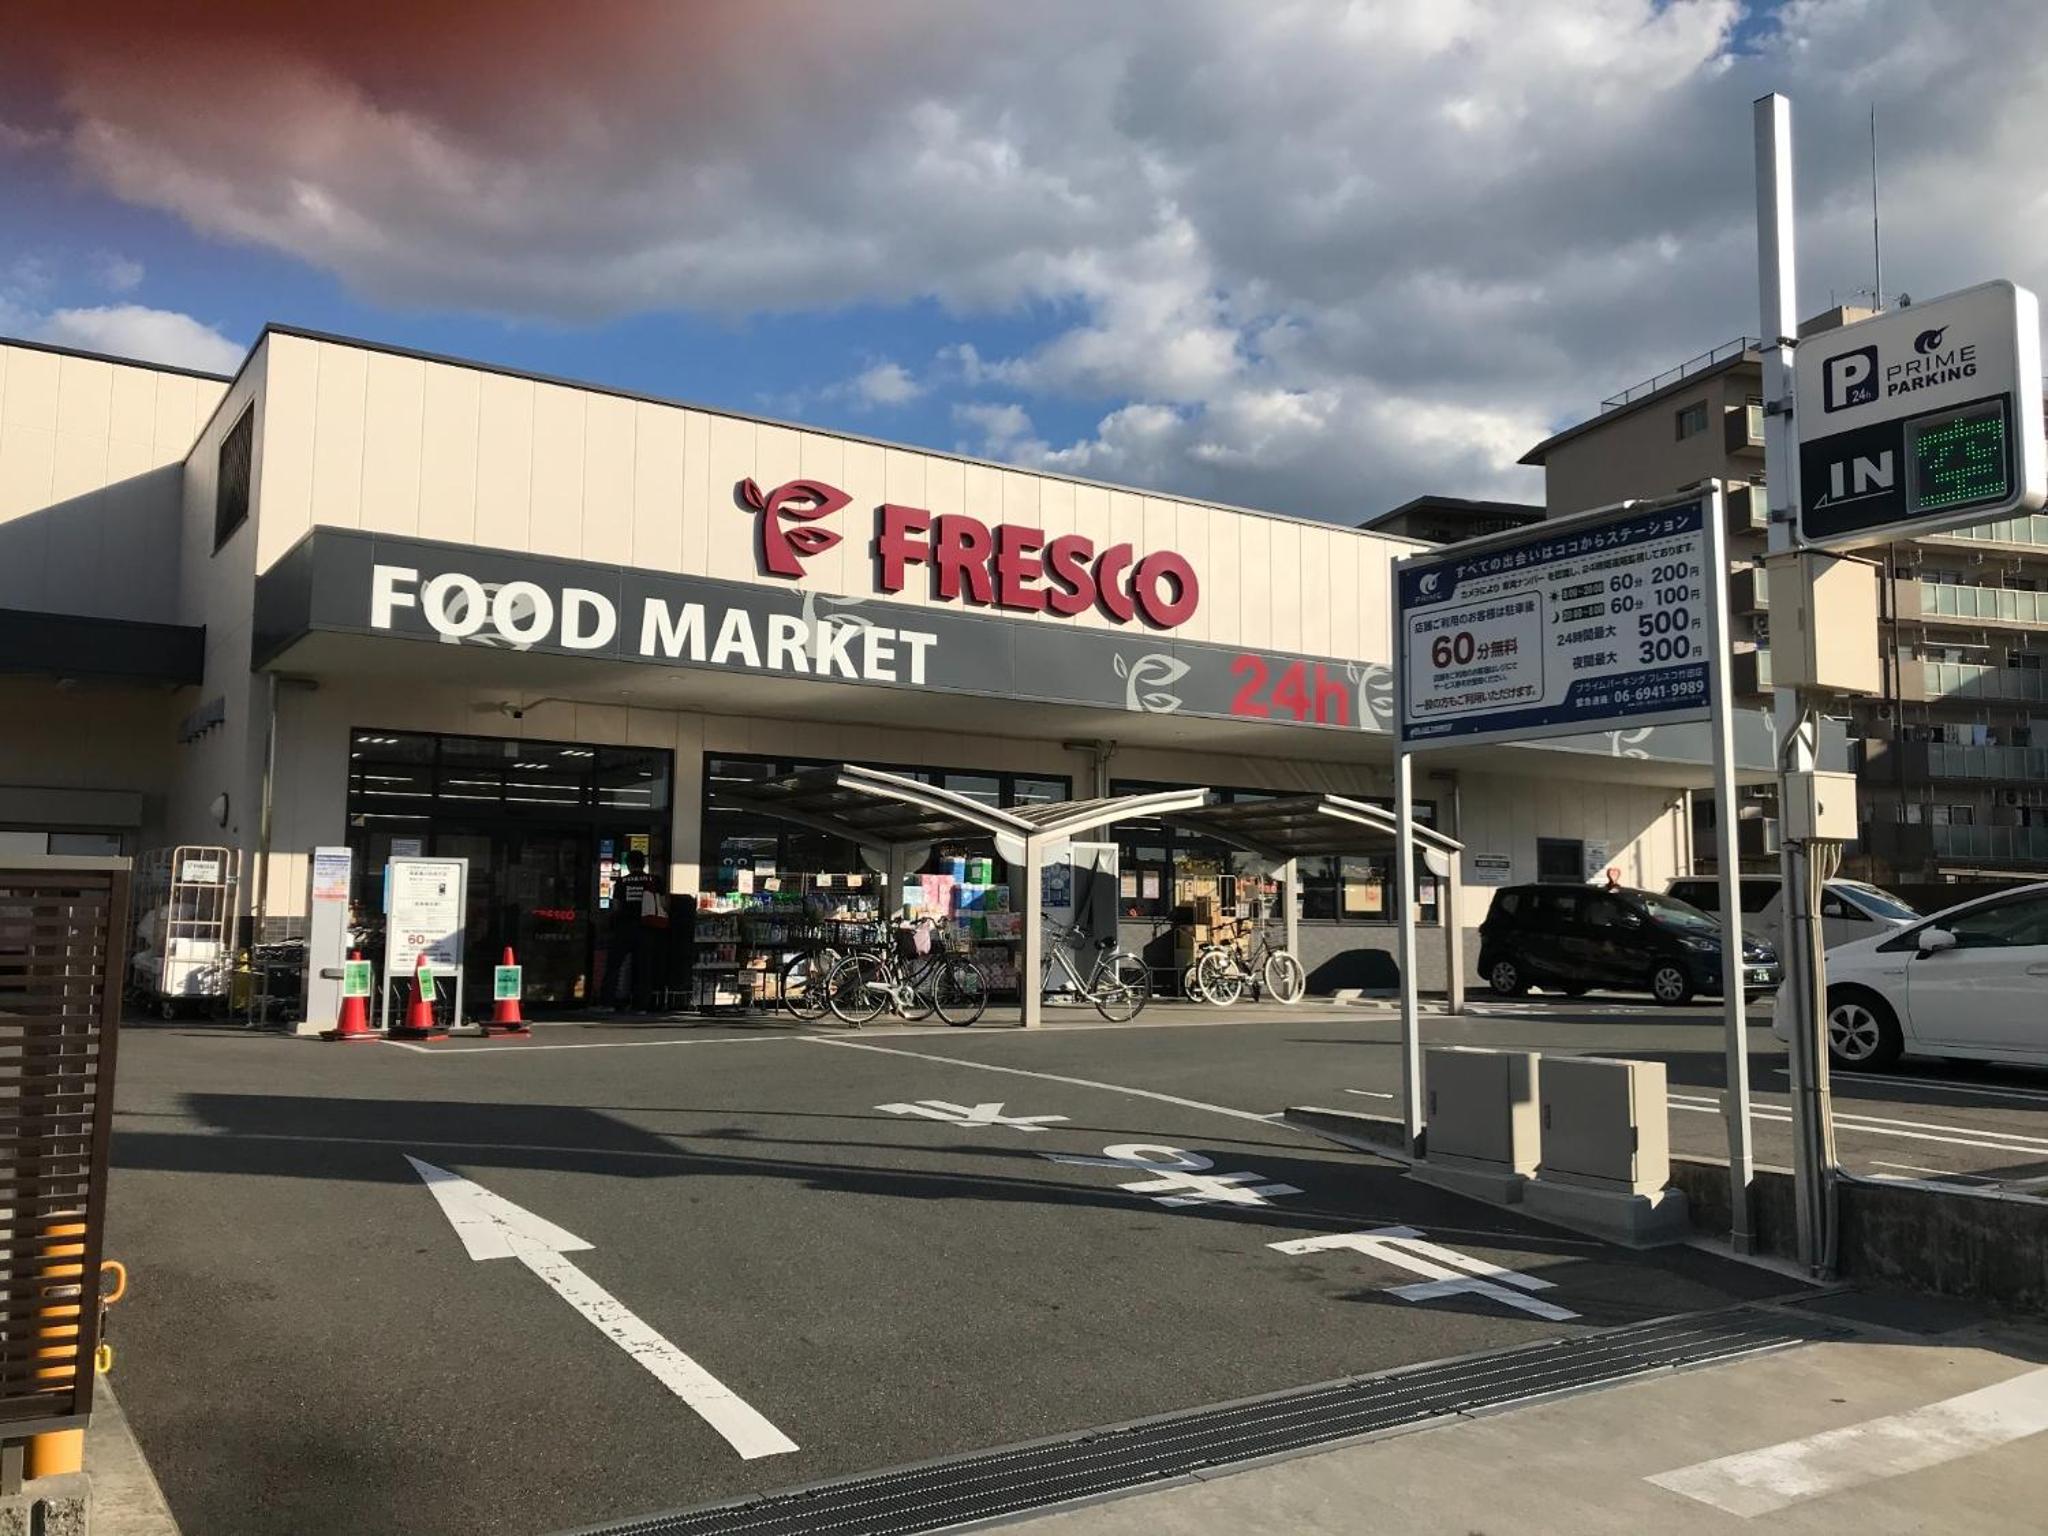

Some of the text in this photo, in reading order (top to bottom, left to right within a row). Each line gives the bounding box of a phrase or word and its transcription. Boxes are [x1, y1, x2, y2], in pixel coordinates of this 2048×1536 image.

[1831, 353, 1872, 408] P
[1886, 344, 1976, 382] PRIME
[1887, 362, 1977, 397] PARKING
[1830, 449, 1895, 499] IN
[1918, 417, 2006, 506] 空
[874, 503, 1199, 630] FRESCO
[1455, 515, 1690, 578] すべての出会いはココからステーション
[1610, 573, 1643, 592] 60分
[1651, 561, 1700, 584] 200円
[1611, 595, 1644, 614] 60分
[1654, 584, 1701, 606] 100円
[370, 563, 938, 685] FOOD MARKET
[1556, 607, 1701, 647] 24時間最大 500円
[1432, 631, 1518, 669] 60分無料
[1572, 634, 1703, 670] 夜間最大 300円
[1230, 653, 1350, 728] 24h
[1614, 680, 1704, 703] 06-6941-9989
